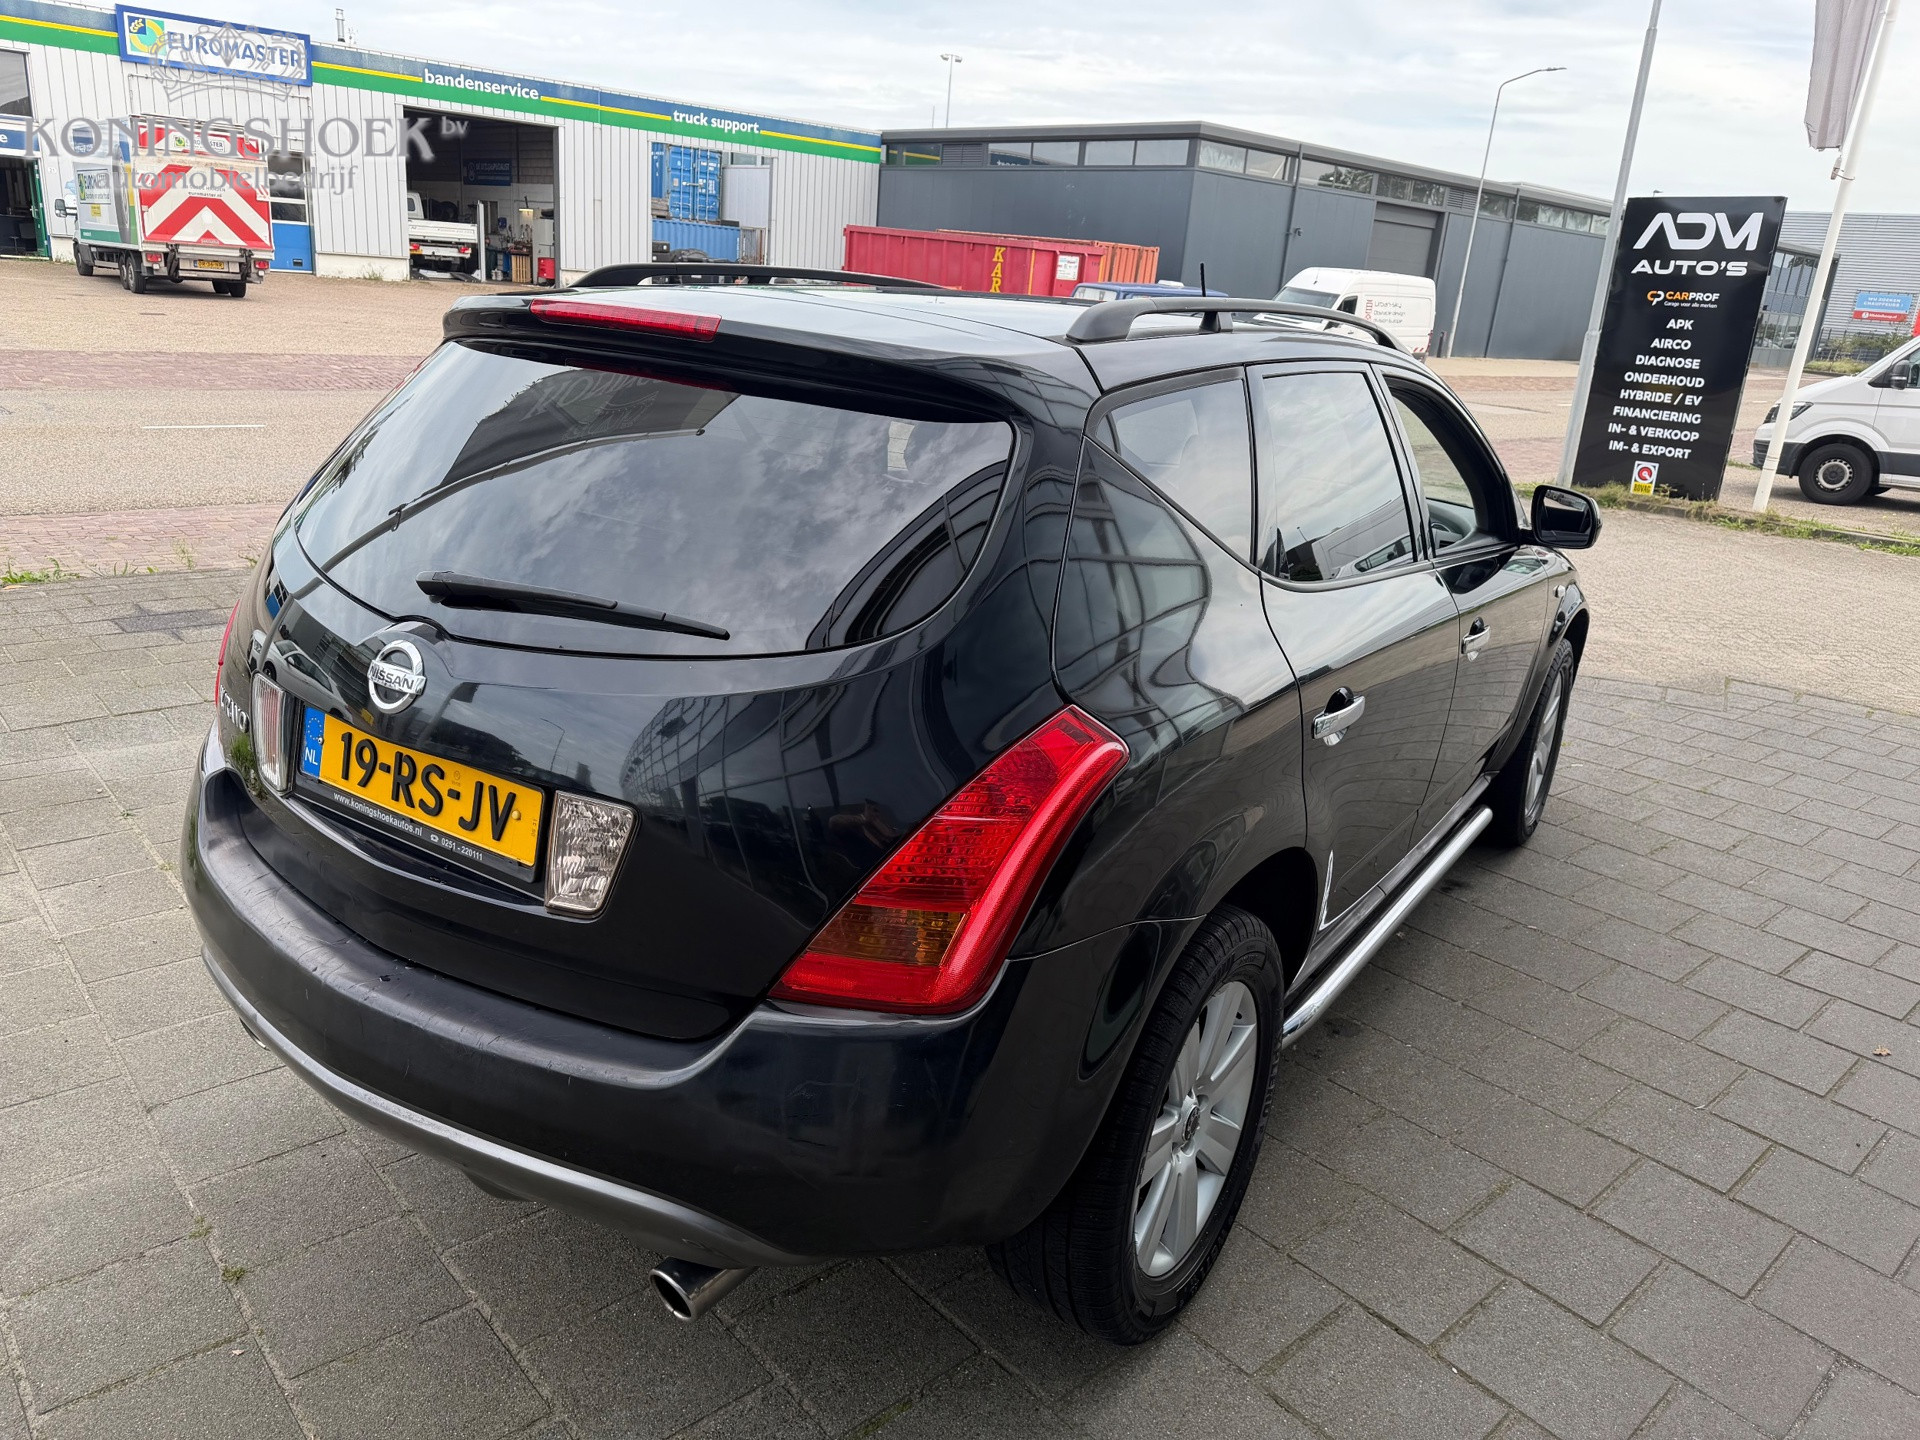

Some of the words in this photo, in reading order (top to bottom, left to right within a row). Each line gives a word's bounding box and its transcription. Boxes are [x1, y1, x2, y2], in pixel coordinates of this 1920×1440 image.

[167, 31, 301, 67] EUROMASTER
[424, 68, 539, 99] bandenservice
[673, 110, 708, 126] truck
[711, 117, 759, 134] support
[1633, 212, 1764, 250] ADM
[1631, 259, 1748, 276] AUTO'S
[1666, 291, 1720, 301] CARPROF
[1666, 319, 1694, 330] APK
[1650, 338, 1691, 350] AIRCO
[1635, 354, 1701, 369] DIAGNOSE
[1624, 371, 1705, 388] ONDERHOUD
[1620, 389, 1673, 403] HYBRIDE
[1673, 393, 1683, 405] /
[1684, 395, 1702, 406] EV
[1613, 405, 1702, 424] FINANCIERING
[1608, 422, 1626, 433] IN-
[1628, 425, 1637, 435] &
[1640, 426, 1700, 442] VERKOOP
[1609, 440, 1629, 451] IM-
[1631, 443, 1640, 453] &
[1641, 444, 1691, 459] EXPORT
[369, 665, 414, 690] NISSAN
[304, 748, 318, 766] NL
[341, 731, 517, 842] 19-RS-JV
[333, 792, 423, 837] www.koningshoekautos.nl
[441, 837, 456, 850] 0251
[461, 845, 483, 861] 220111
